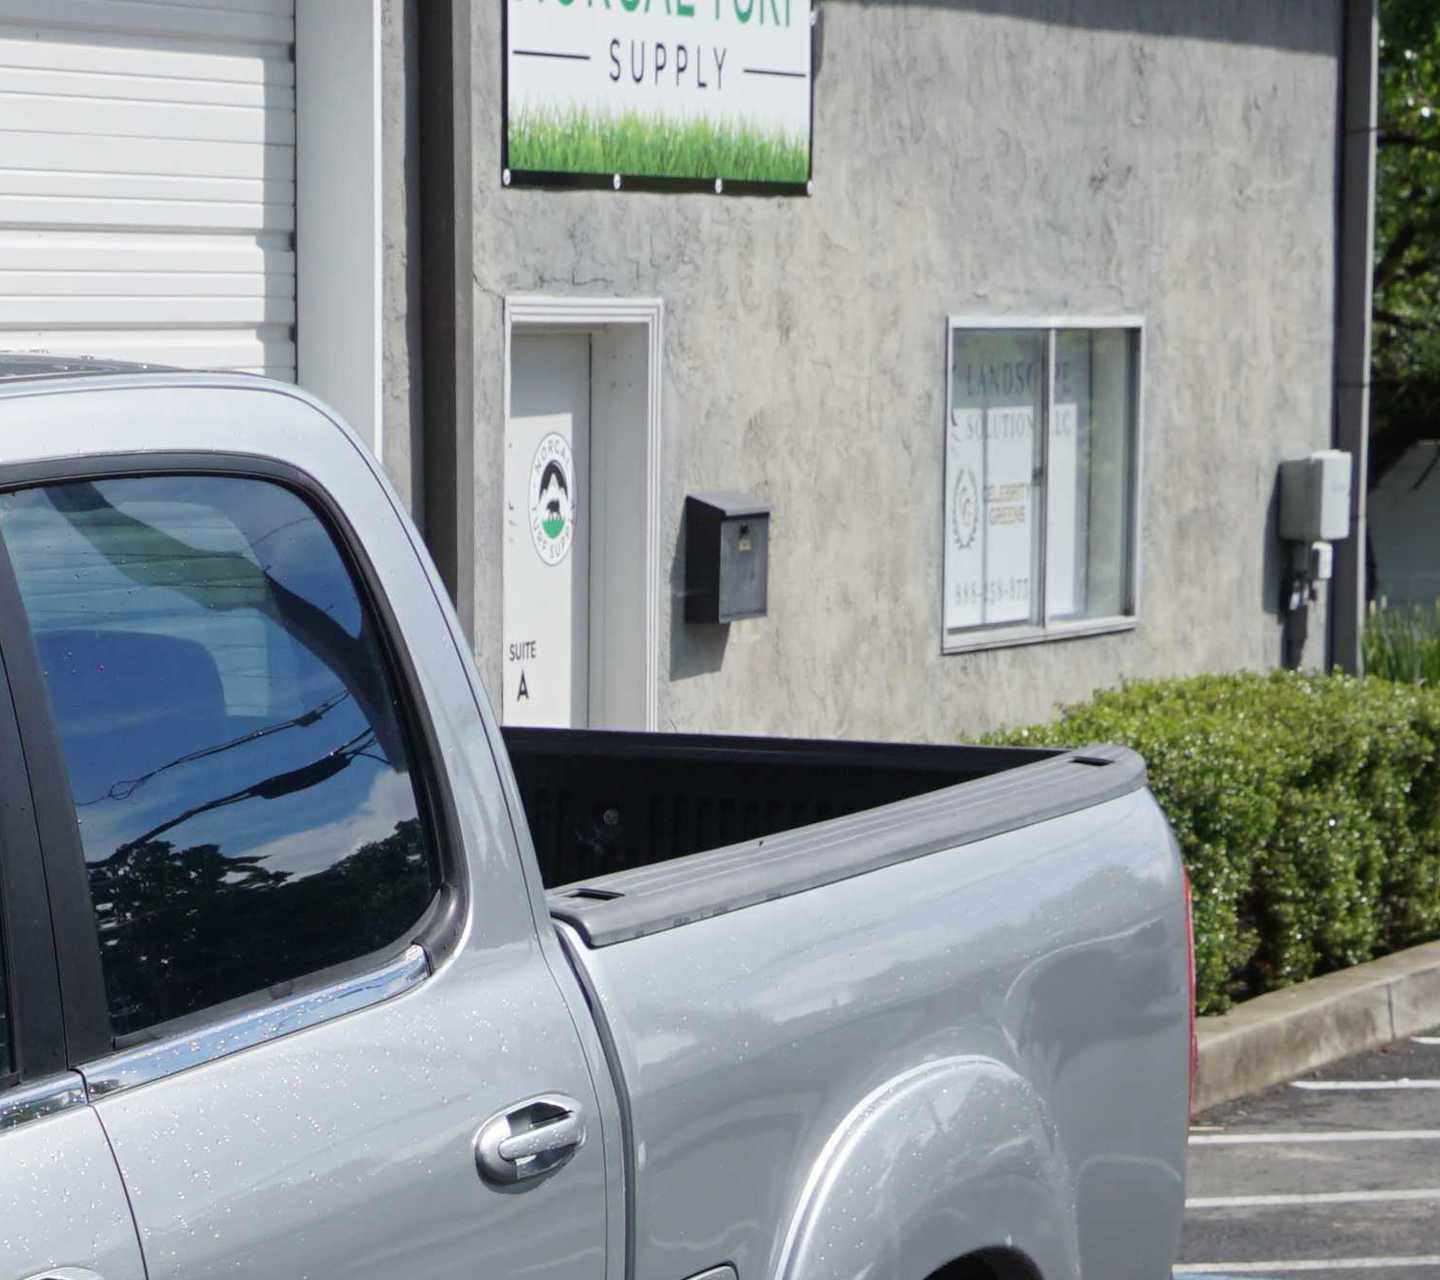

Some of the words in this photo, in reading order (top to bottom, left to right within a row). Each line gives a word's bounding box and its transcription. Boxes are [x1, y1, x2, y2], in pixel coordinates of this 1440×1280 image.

[609, 38, 727, 90] SUPPLY
[509, 640, 537, 662] SUITE
[517, 670, 530, 702] A
